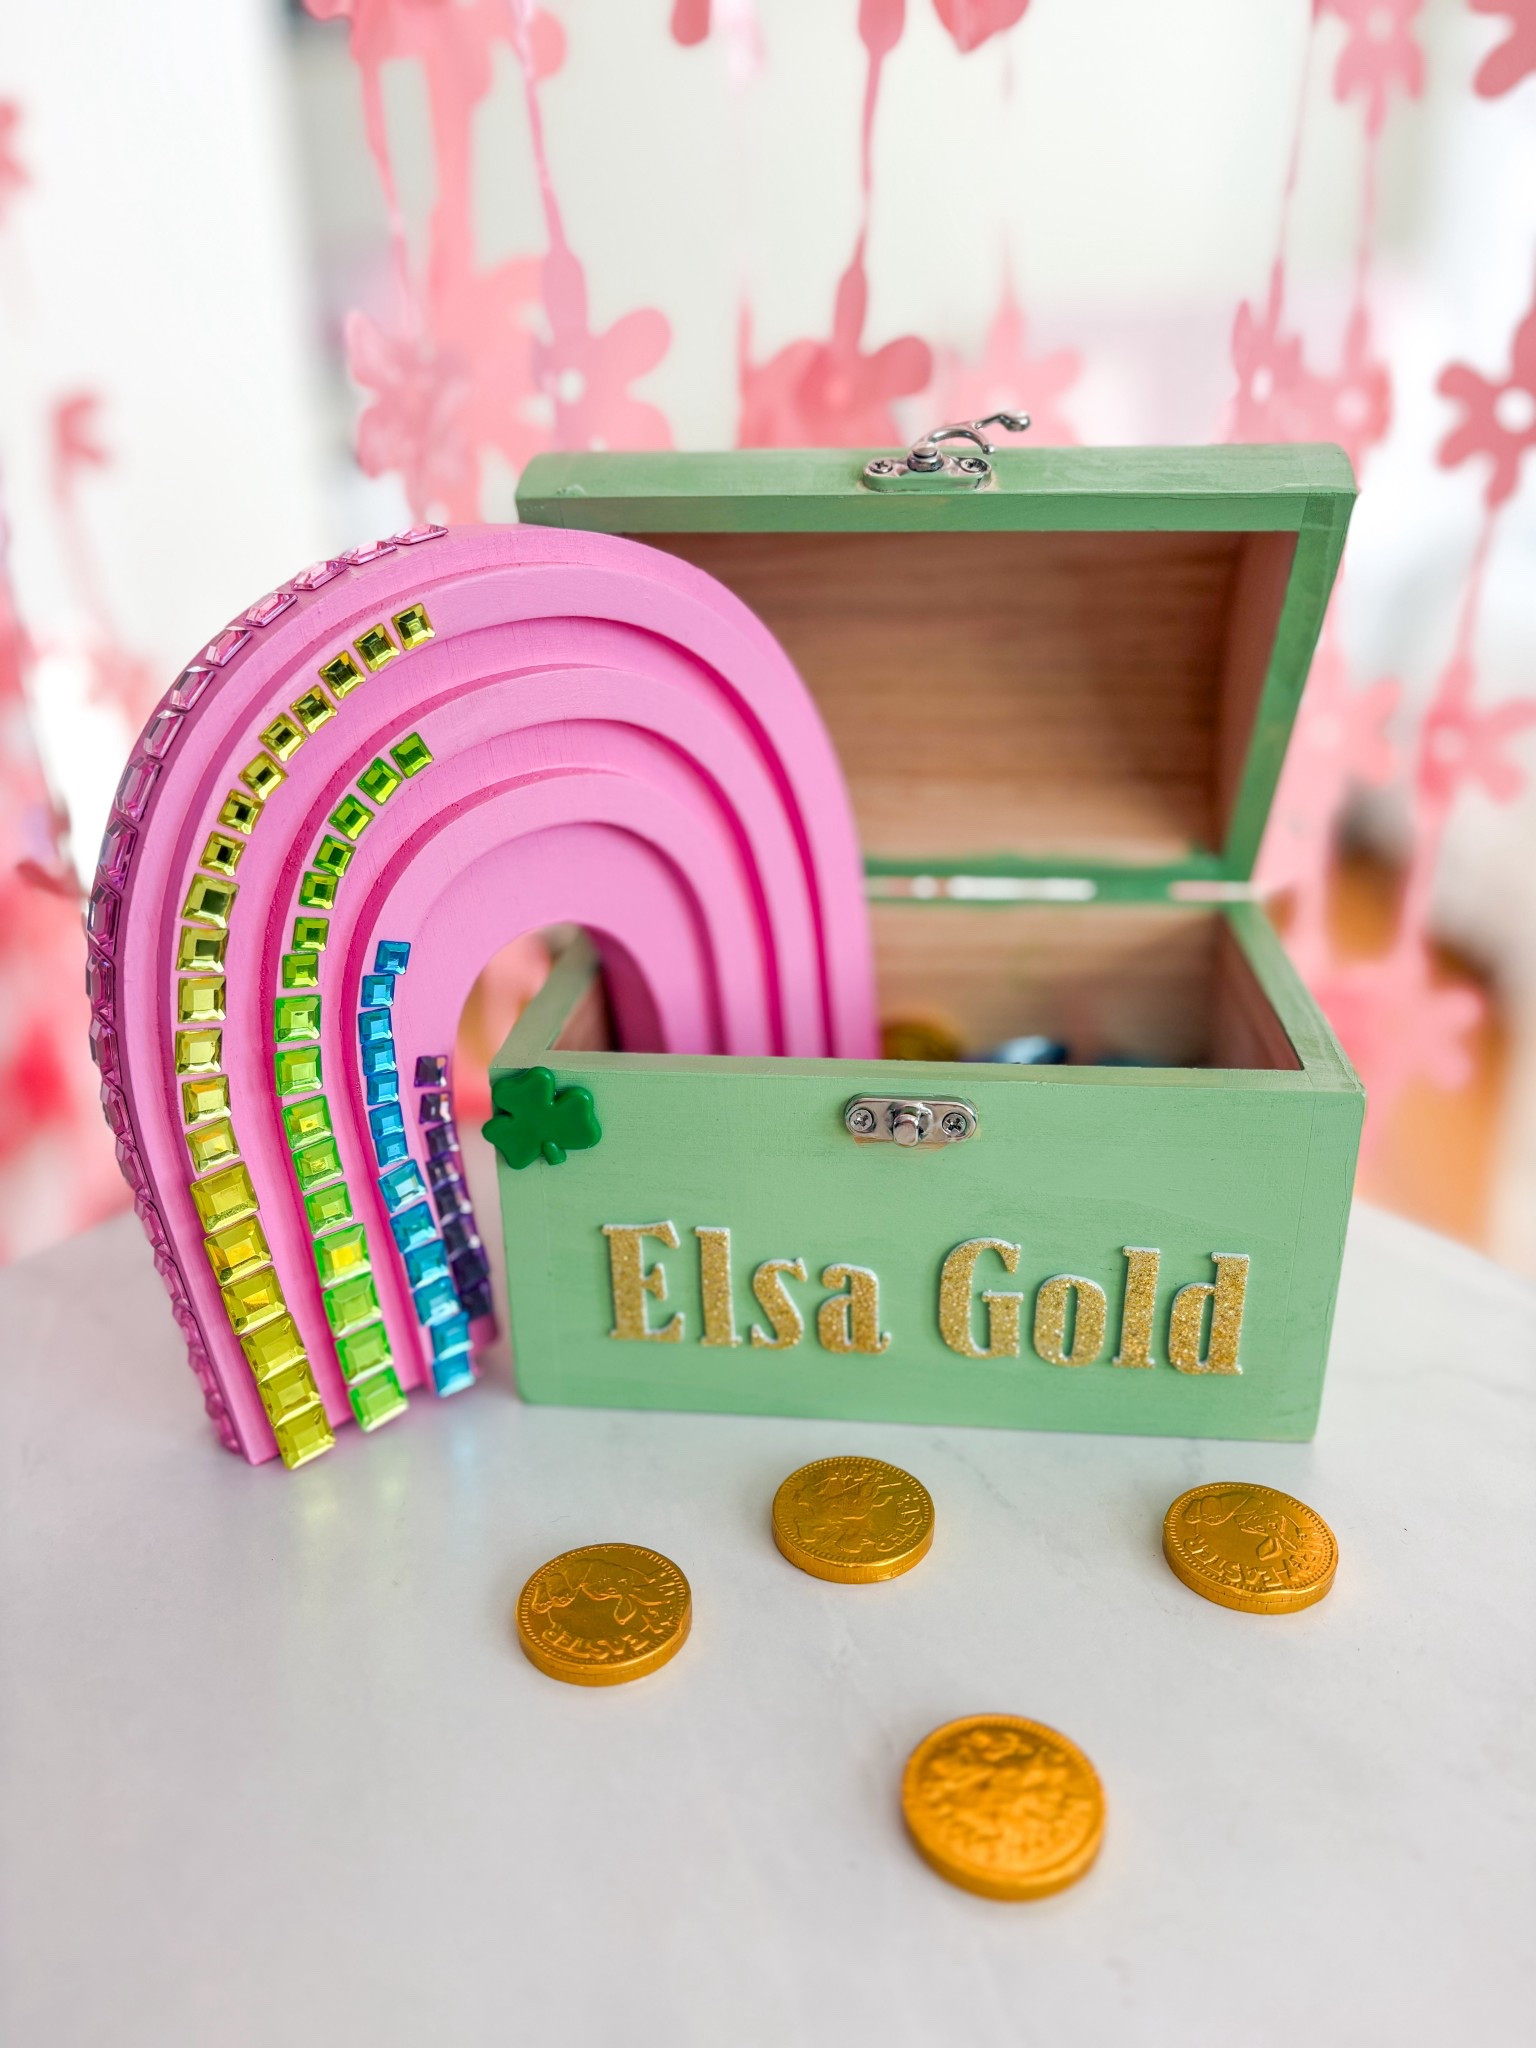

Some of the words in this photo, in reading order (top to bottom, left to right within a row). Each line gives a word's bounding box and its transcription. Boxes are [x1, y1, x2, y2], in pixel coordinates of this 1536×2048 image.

[602, 1220, 891, 1354] Elsa
[938, 1237, 1249, 1375] Gold
[1183, 1535, 1283, 1588] EASTER
[541, 1626, 650, 1660] EASTER
